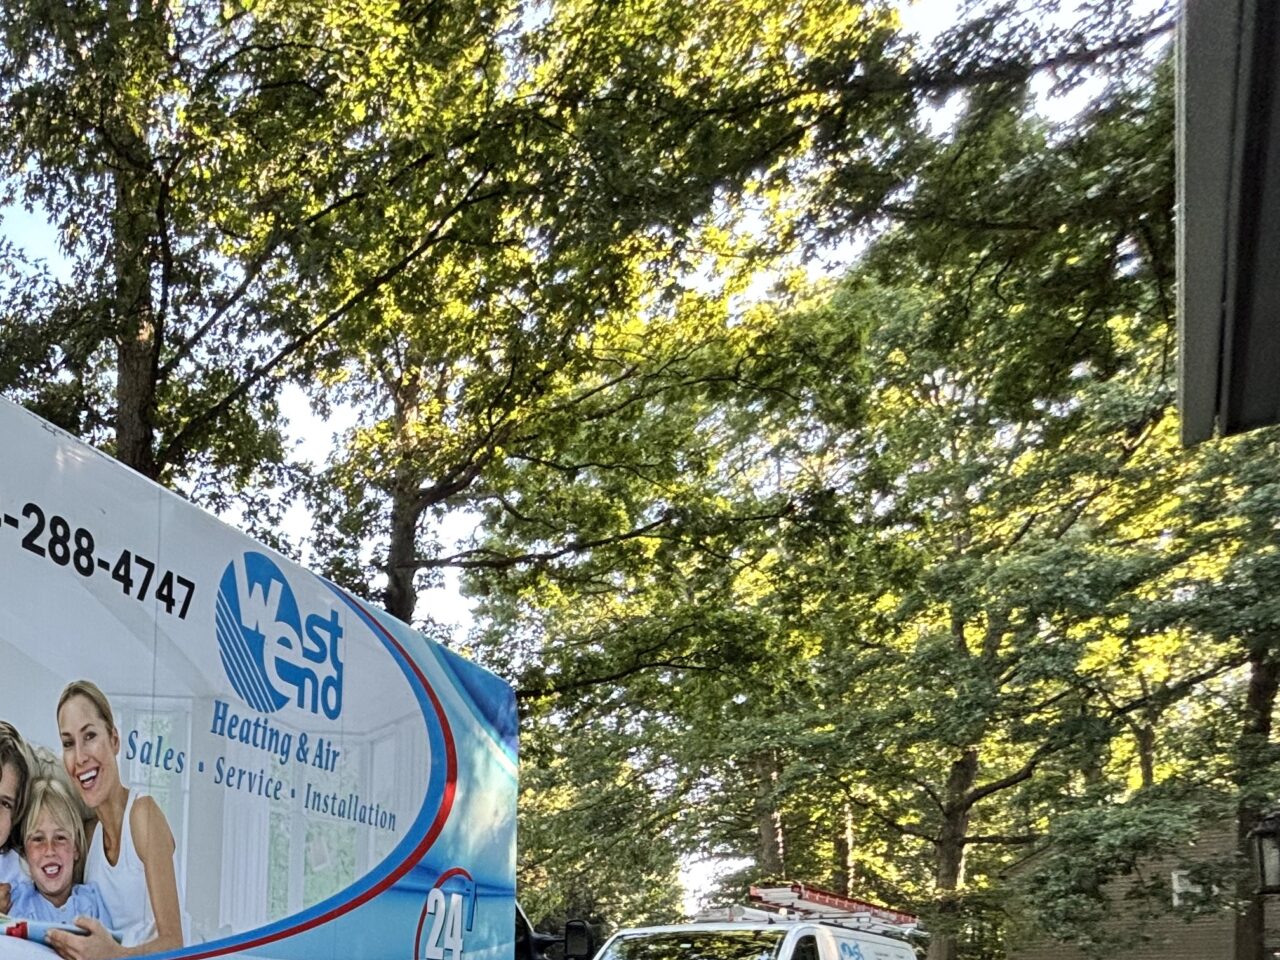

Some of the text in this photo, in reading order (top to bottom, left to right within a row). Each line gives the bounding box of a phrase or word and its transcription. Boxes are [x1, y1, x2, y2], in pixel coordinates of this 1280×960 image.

[232, 553, 344, 664] West
[126, 730, 398, 832] Sales Service Installation
[210, 700, 340, 773] Heating & Air
